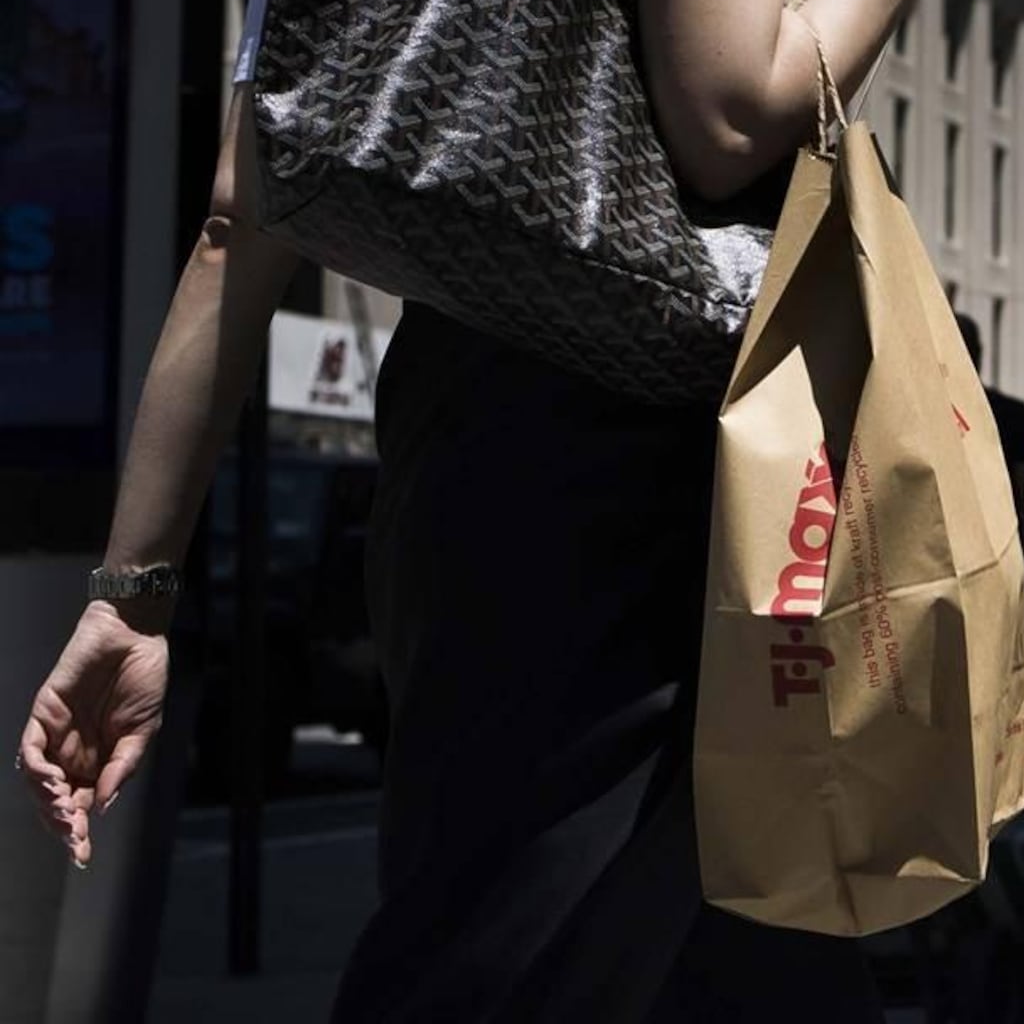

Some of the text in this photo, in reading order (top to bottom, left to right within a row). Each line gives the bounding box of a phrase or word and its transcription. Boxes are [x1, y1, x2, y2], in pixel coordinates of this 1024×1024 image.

[842, 485, 855, 515] recy
[862, 630, 876, 659] bag
[865, 661, 881, 688] this
